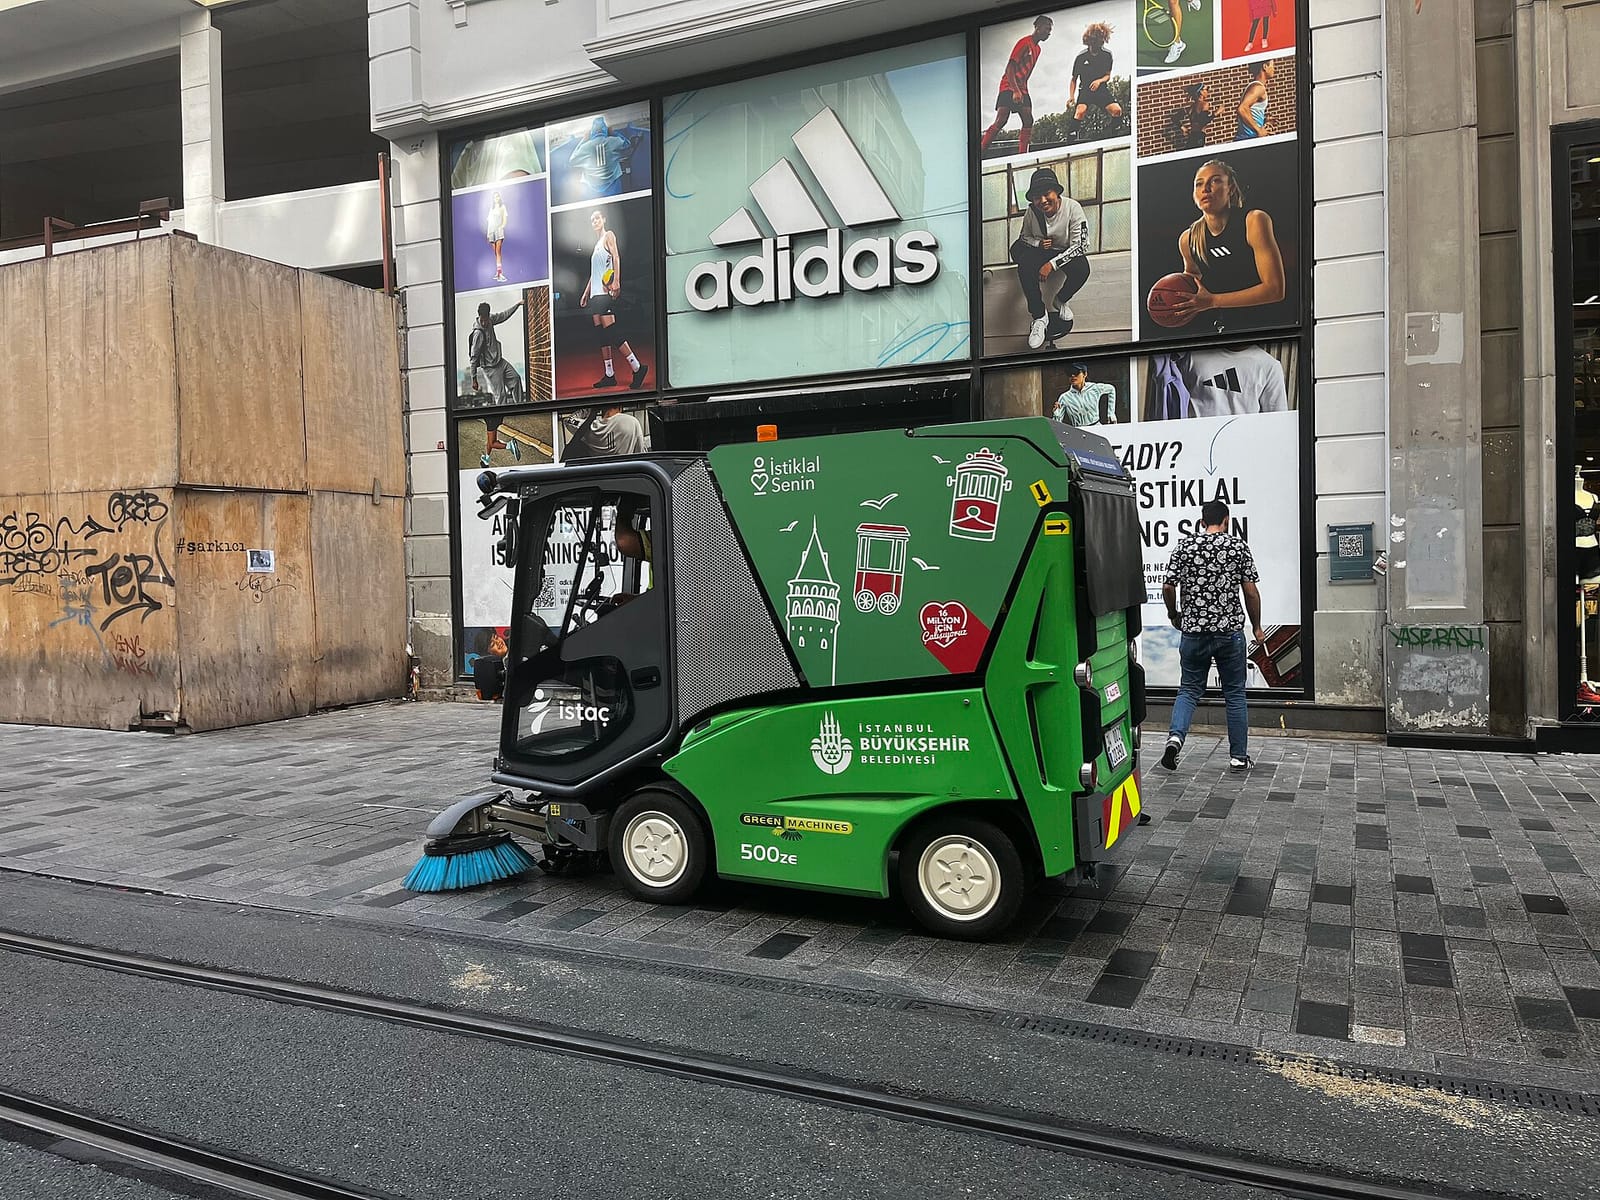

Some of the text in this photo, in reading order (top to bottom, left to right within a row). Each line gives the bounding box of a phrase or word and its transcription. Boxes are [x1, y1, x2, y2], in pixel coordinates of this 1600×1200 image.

[685, 228, 940, 311] adidas
[770, 456, 820, 476] İstiklal
[771, 477, 815, 493] Senin
[559, 700, 610, 728] istaç
[858, 722, 934, 733] İSTANBUL
[859, 735, 970, 752] BÜYÜKŞEHİR
[860, 754, 936, 765] BELEDİYESİ
[743, 815, 849, 832] GREEN MACHINES
